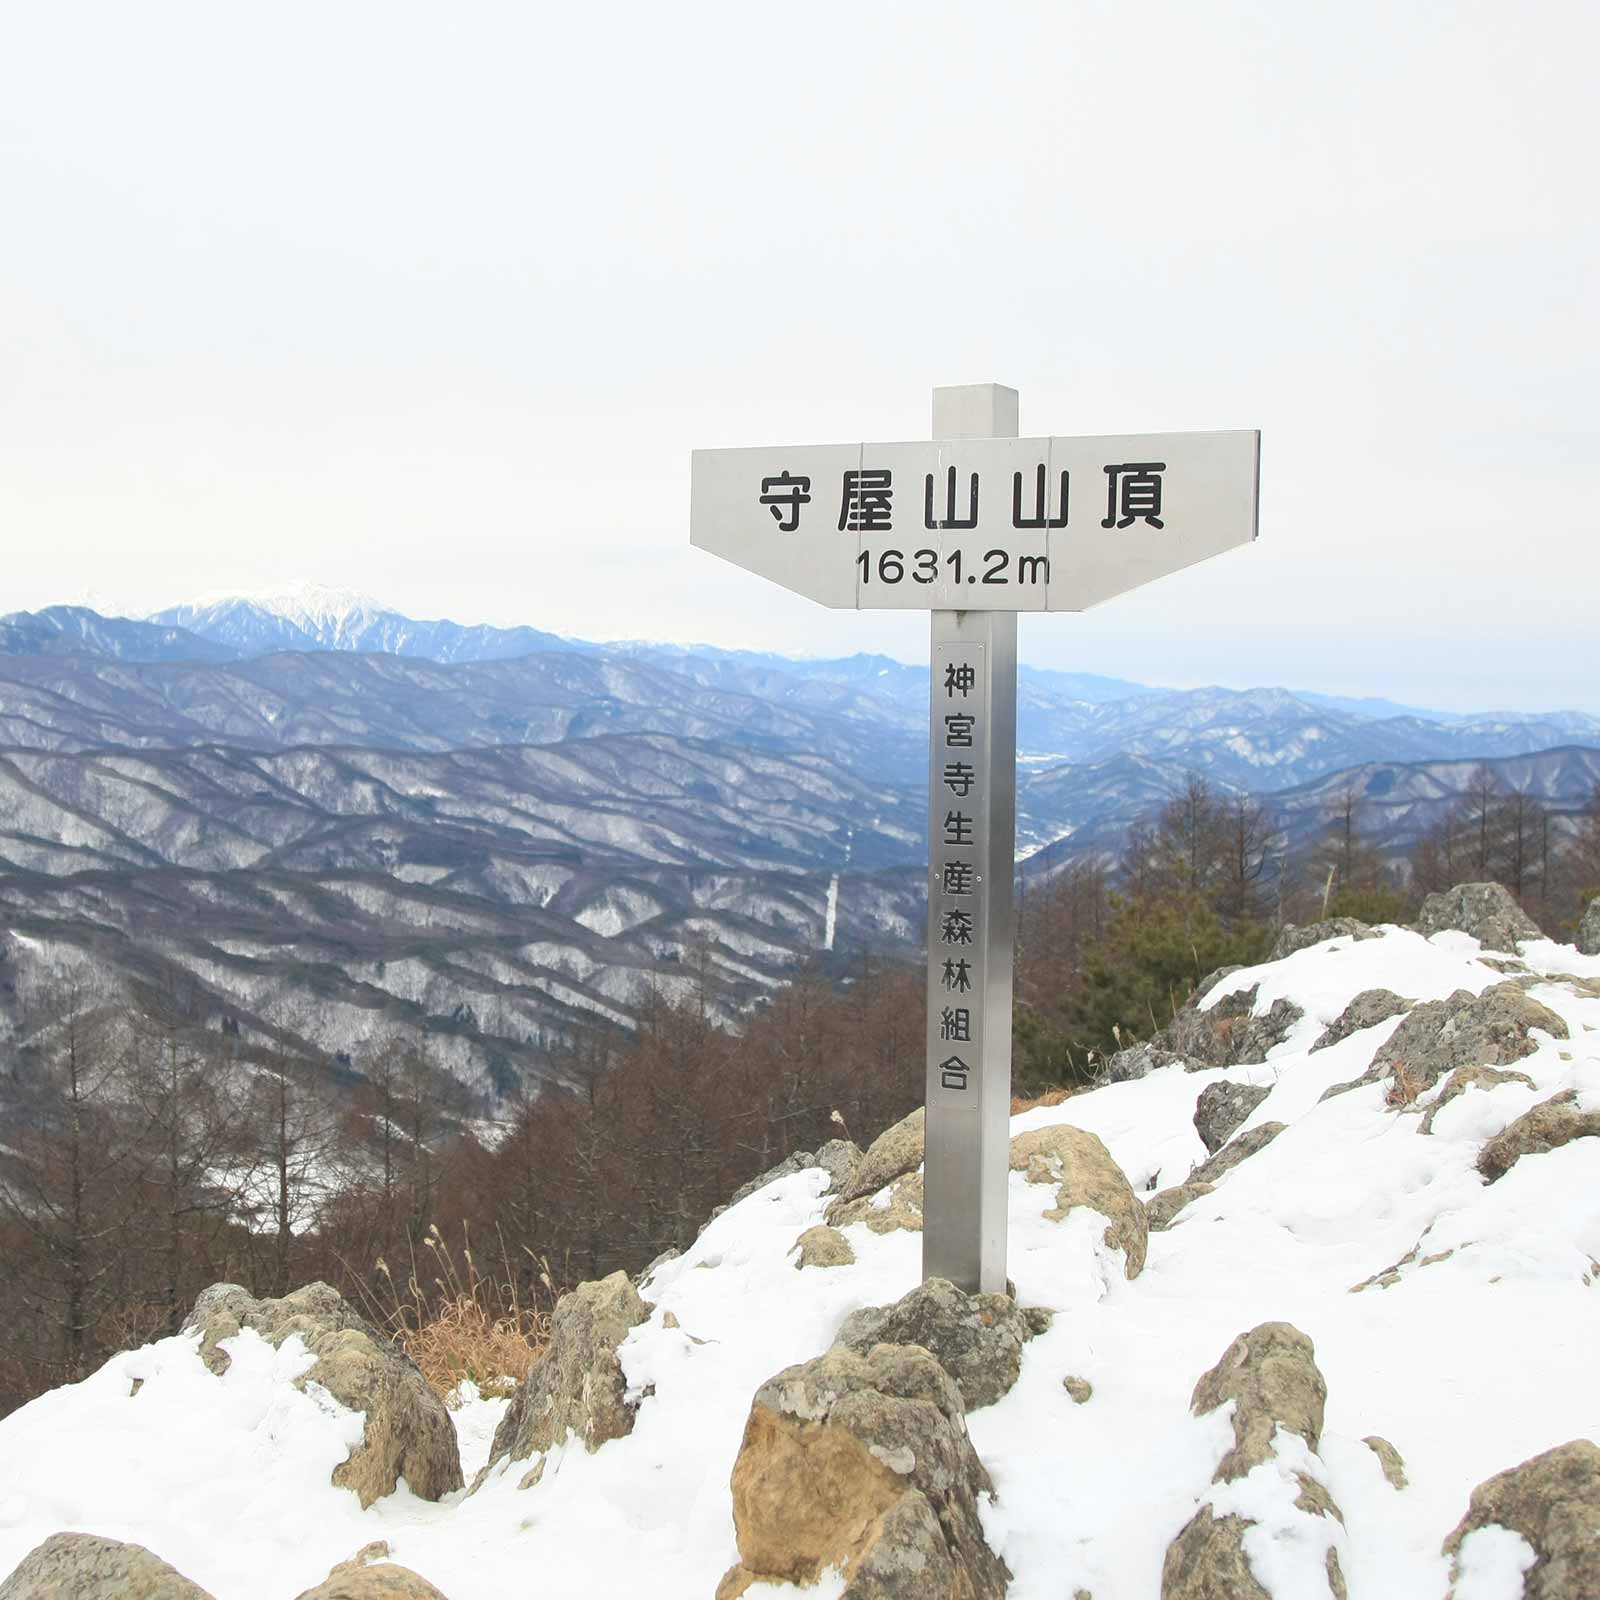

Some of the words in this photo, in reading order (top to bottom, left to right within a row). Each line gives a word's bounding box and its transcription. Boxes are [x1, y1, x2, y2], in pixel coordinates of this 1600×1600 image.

[759, 463, 1167, 532] 守屋山山頂
[856, 549, 1050, 585] 1631.2m
[939, 662, 976, 1091] 神宮寺生産森林組合
